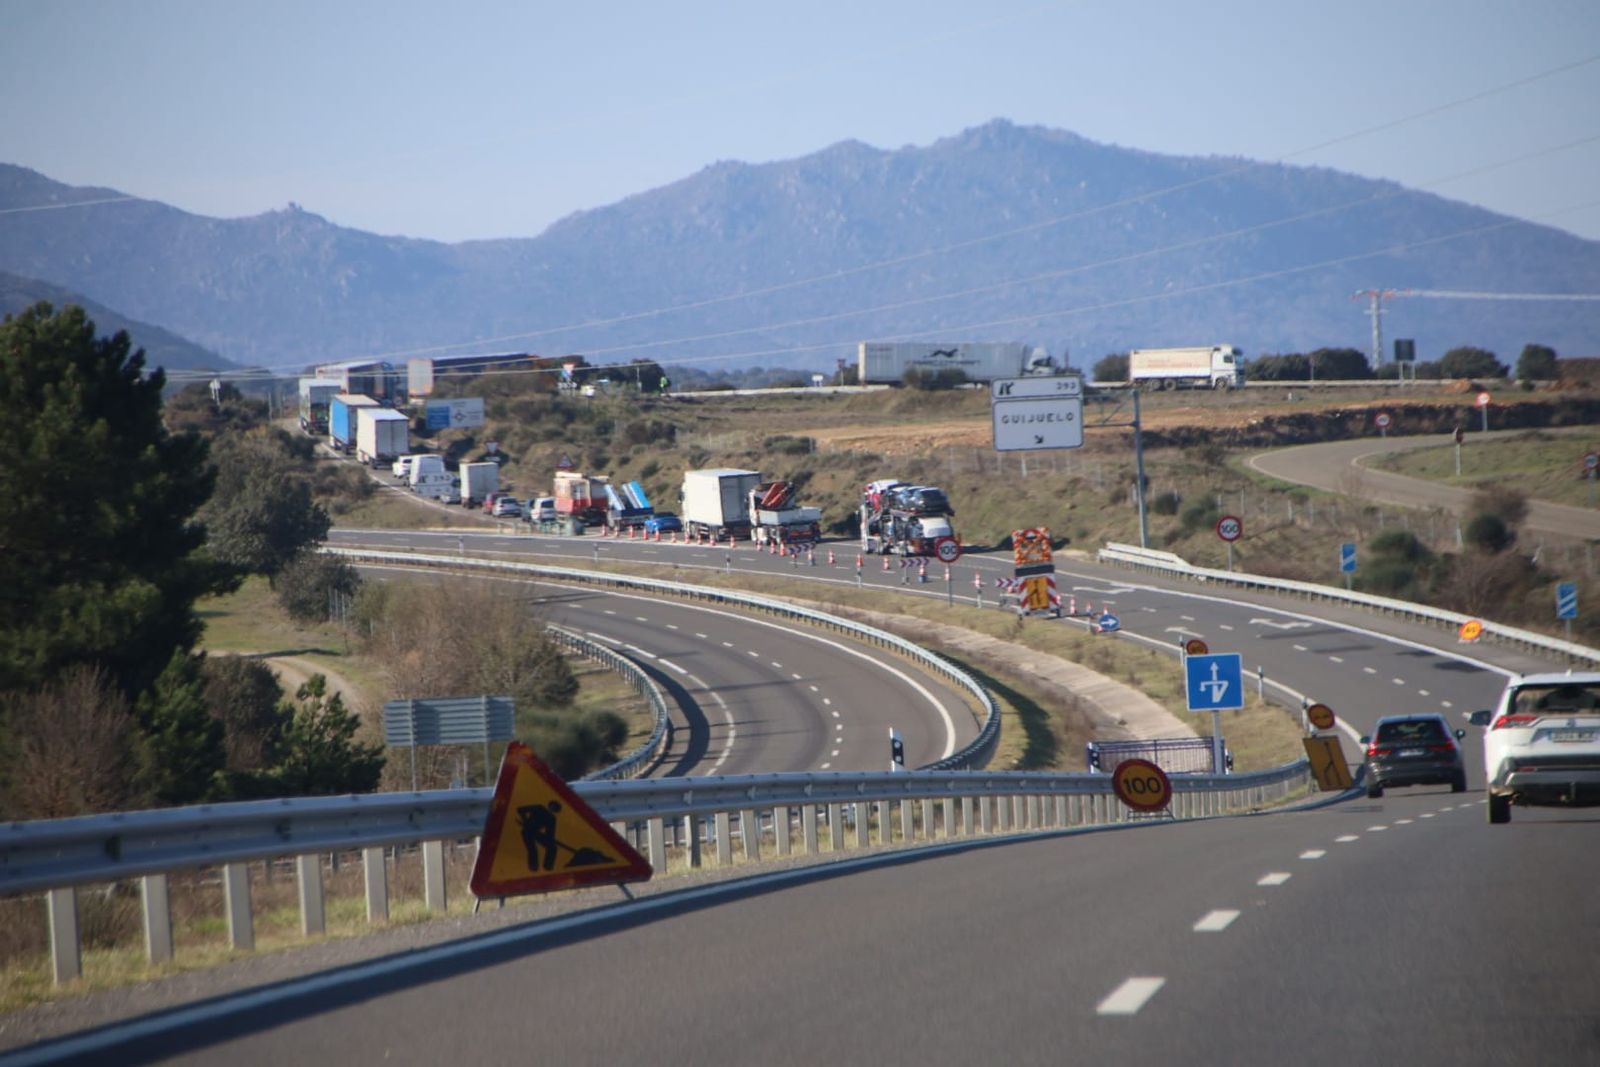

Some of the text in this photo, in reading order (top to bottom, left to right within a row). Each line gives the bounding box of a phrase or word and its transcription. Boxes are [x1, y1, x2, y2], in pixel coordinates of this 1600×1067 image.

[1001, 412, 1075, 424] GUIJUELO
[1221, 524, 1239, 534] 100
[940, 545, 958, 555] 100
[1123, 777, 1162, 794] 100
